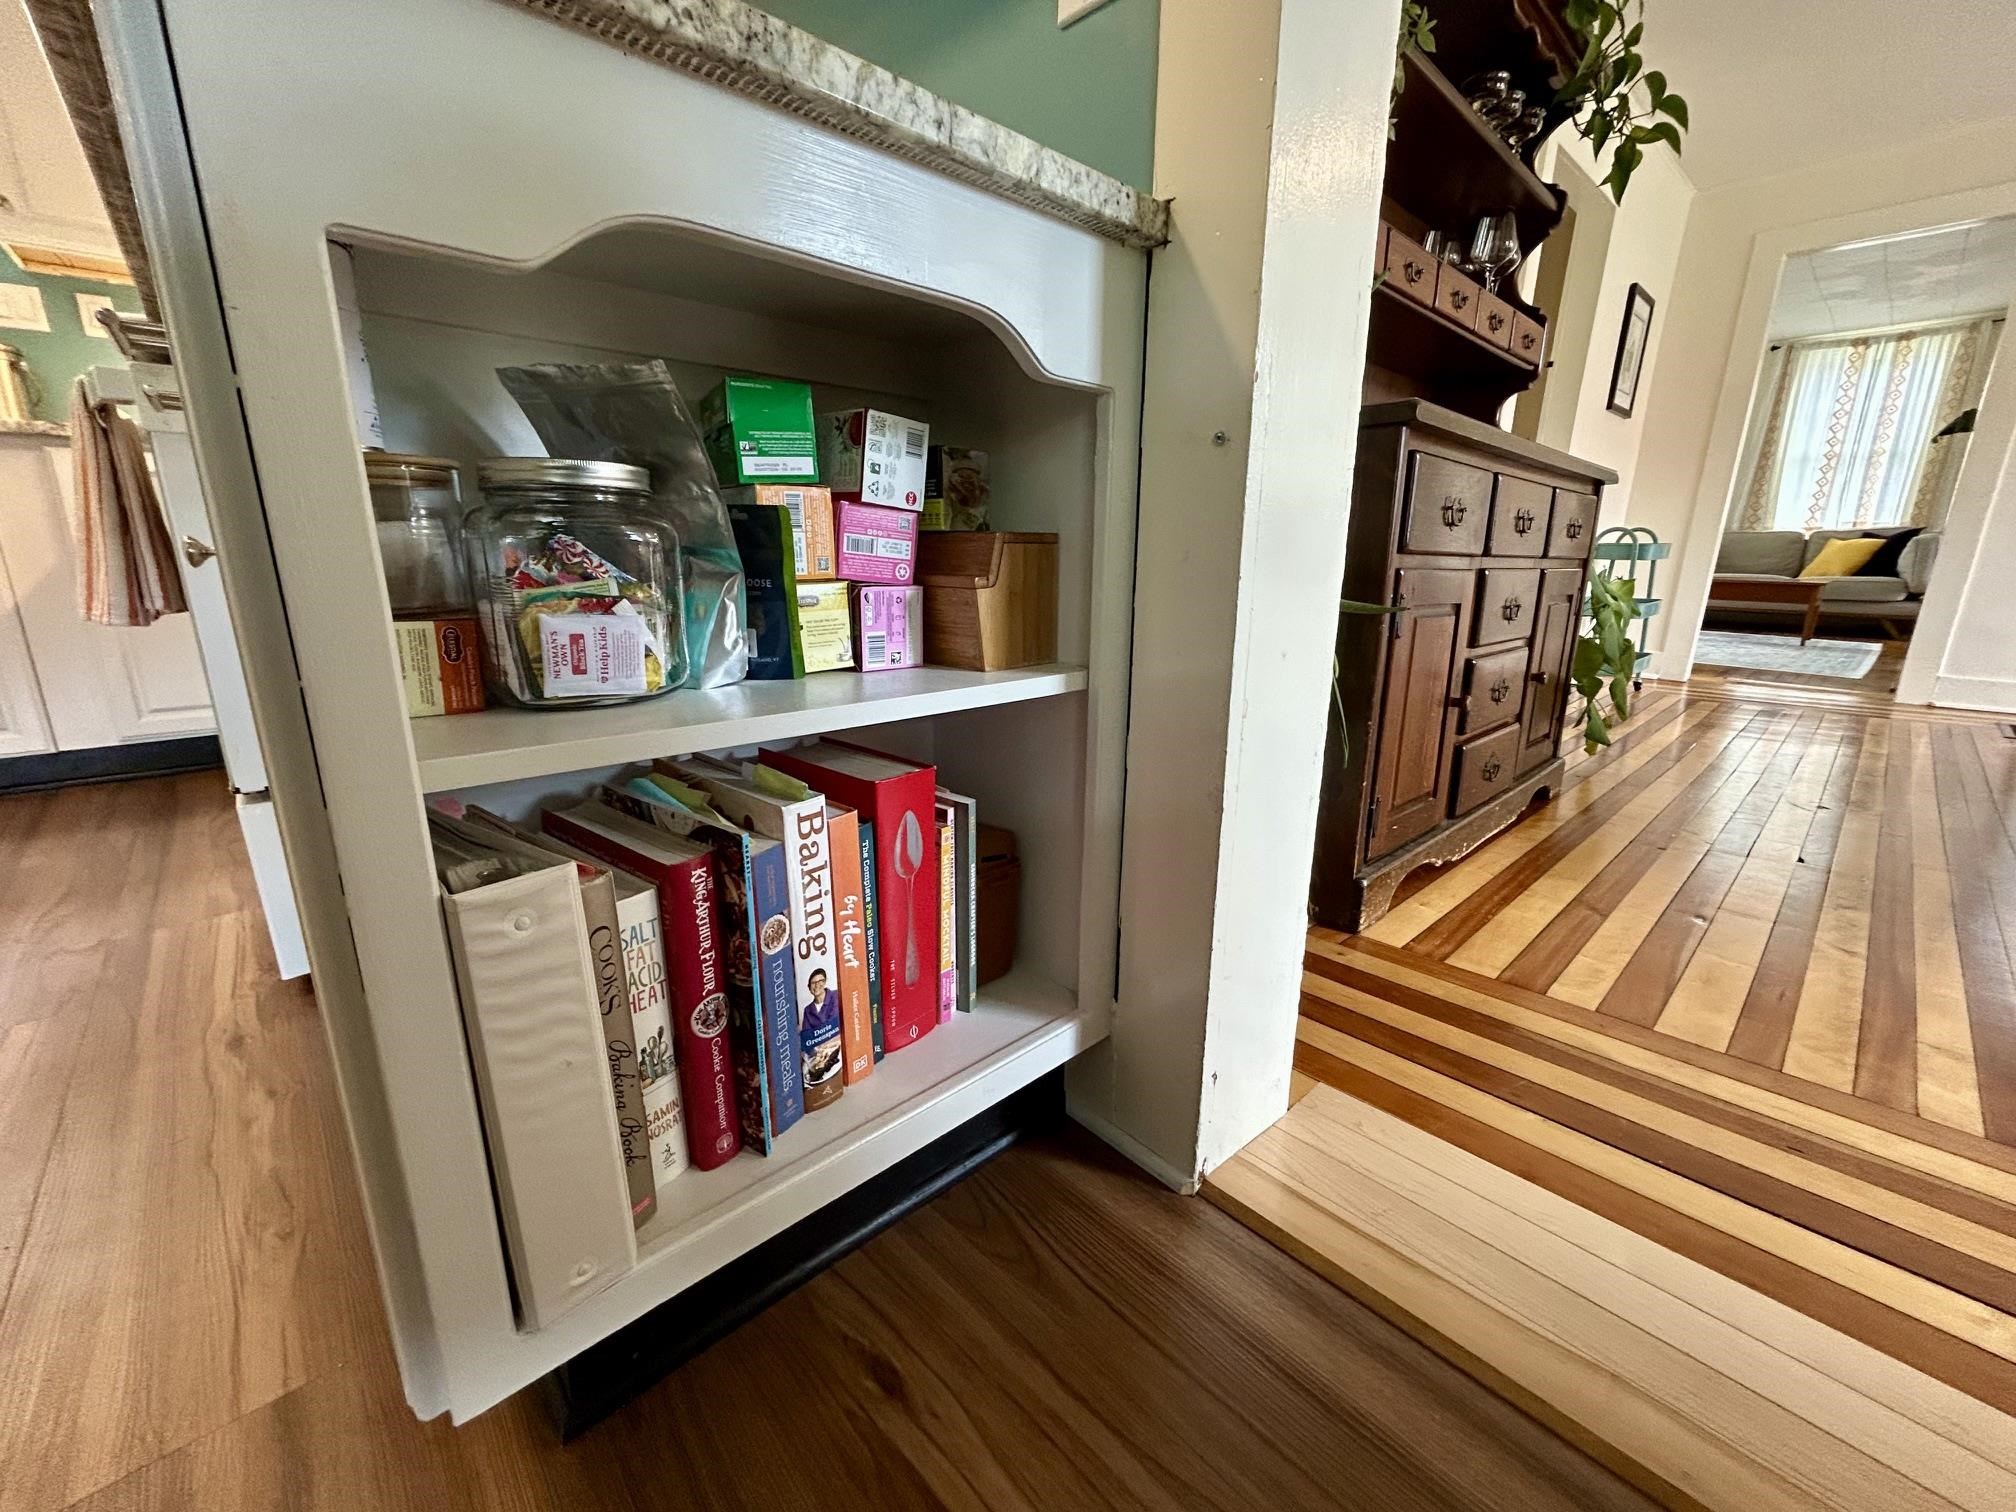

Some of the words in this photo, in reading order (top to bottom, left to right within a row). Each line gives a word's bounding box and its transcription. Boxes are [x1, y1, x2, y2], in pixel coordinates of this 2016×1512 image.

[746, 579, 773, 588] OOSE
[549, 630, 561, 679] NEWMAN'S
[560, 643, 569, 666] OWN
[598, 626, 608, 650] Kids
[578, 652, 586, 670] Black
[599, 652, 611, 675] Help
[690, 866, 708, 904] KING
[706, 876, 714, 889] THE
[797, 806, 830, 961] Baking
[863, 860, 871, 903] Complete
[943, 854, 951, 903] MINDFUL
[839, 895, 859, 916] by
[620, 917, 658, 950] SALT
[696, 901, 712, 954] ARTHUR
[840, 919, 861, 969] Heart
[867, 928, 875, 951] Slow
[943, 909, 951, 965] MOCKTAIL
[589, 925, 622, 1016] COOK'S
[626, 940, 657, 971] FAT
[700, 949, 716, 996] FLOUR
[868, 952, 876, 982] Cooker
[628, 961, 662, 994] ACID
[629, 979, 667, 1014] HEAT
[772, 958, 790, 1046] nourishing
[805, 1026, 840, 1046] Greenspan
[813, 1024, 832, 1037] Dorie
[711, 1037, 723, 1073] Cookie
[854, 1057, 867, 1071] DK
[609, 1040, 636, 1112] Baking
[646, 1096, 680, 1128] SAMIN
[714, 1073, 728, 1129] Companion
[620, 1117, 647, 1168] Book
